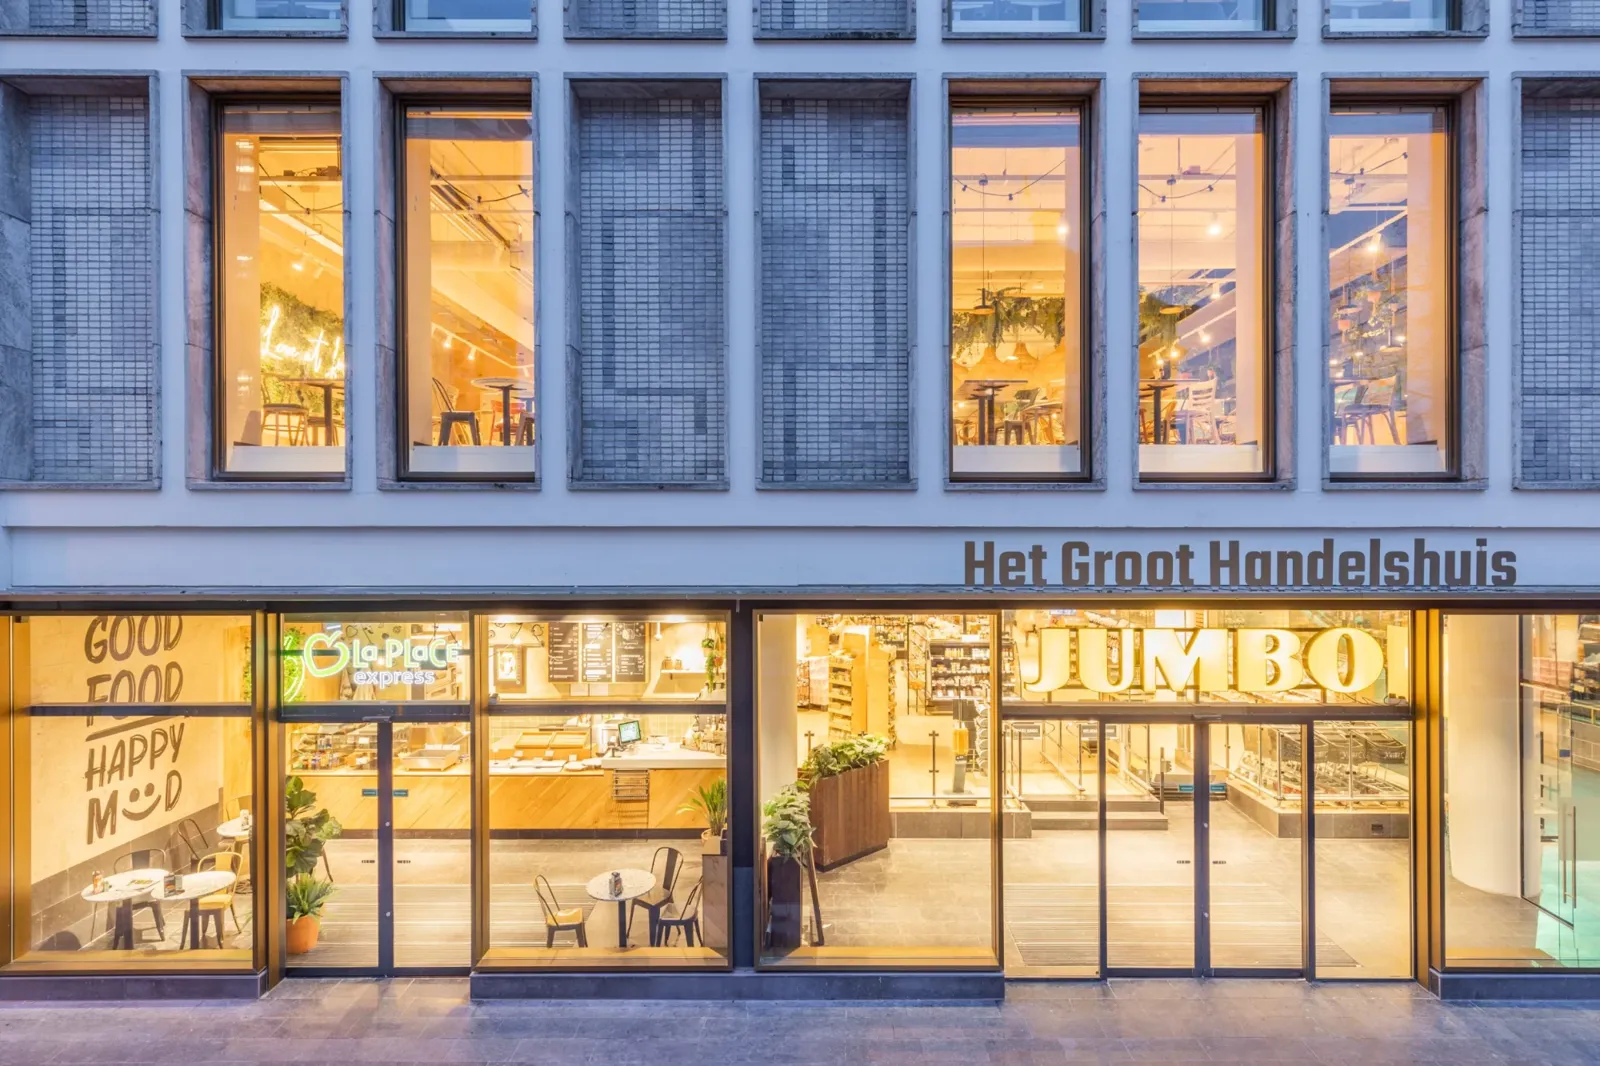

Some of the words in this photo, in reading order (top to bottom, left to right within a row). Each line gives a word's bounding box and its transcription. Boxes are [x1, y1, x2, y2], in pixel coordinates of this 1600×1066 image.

[964, 541, 1047, 586] Het
[1062, 541, 1194, 586] Groot
[1209, 538, 1517, 586] Handelshuis
[84, 615, 183, 664] GOOD
[1023, 627, 1384, 692] JUMBO
[86, 661, 183, 727] FOOD
[353, 670, 435, 689] express
[83, 722, 185, 792] HAPPY
